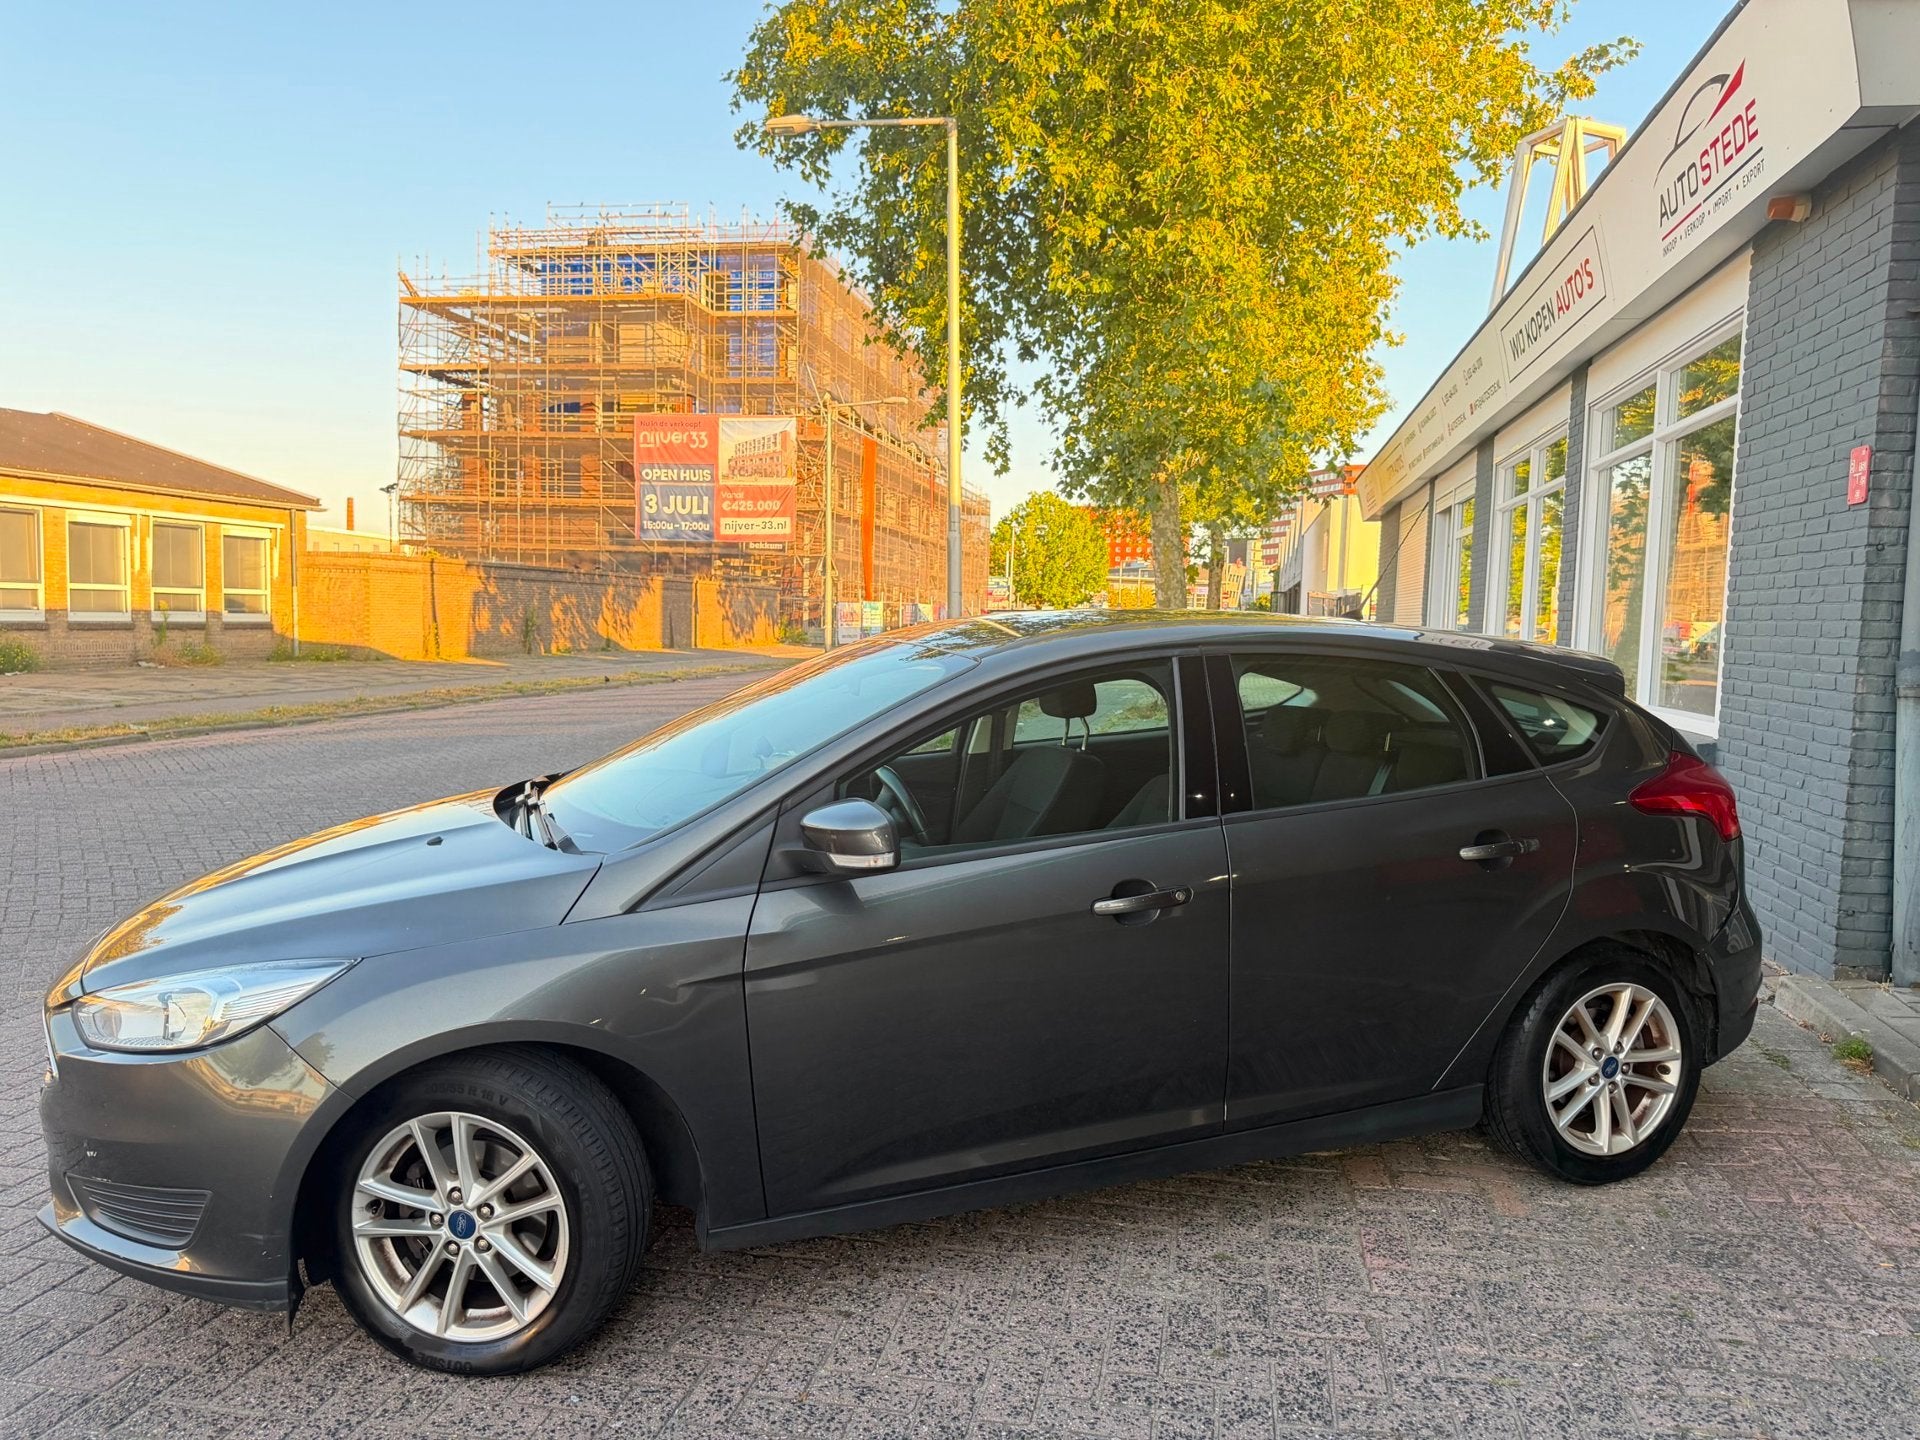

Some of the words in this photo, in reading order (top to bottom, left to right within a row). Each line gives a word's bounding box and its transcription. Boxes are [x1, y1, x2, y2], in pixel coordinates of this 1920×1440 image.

[1712, 187, 1732, 214] IMPORT
[1742, 158, 1765, 188] EXPORT
[1509, 328, 1526, 362] WIJ
[1524, 297, 1556, 349] KOPEN
[1555, 257, 1594, 320] AUTO'S
[641, 468, 677, 481] OPEN
[680, 469, 712, 482] HUIS
[645, 494, 658, 514] 3
[662, 495, 709, 515] JULI
[724, 520, 787, 533] nijver-33.nl
